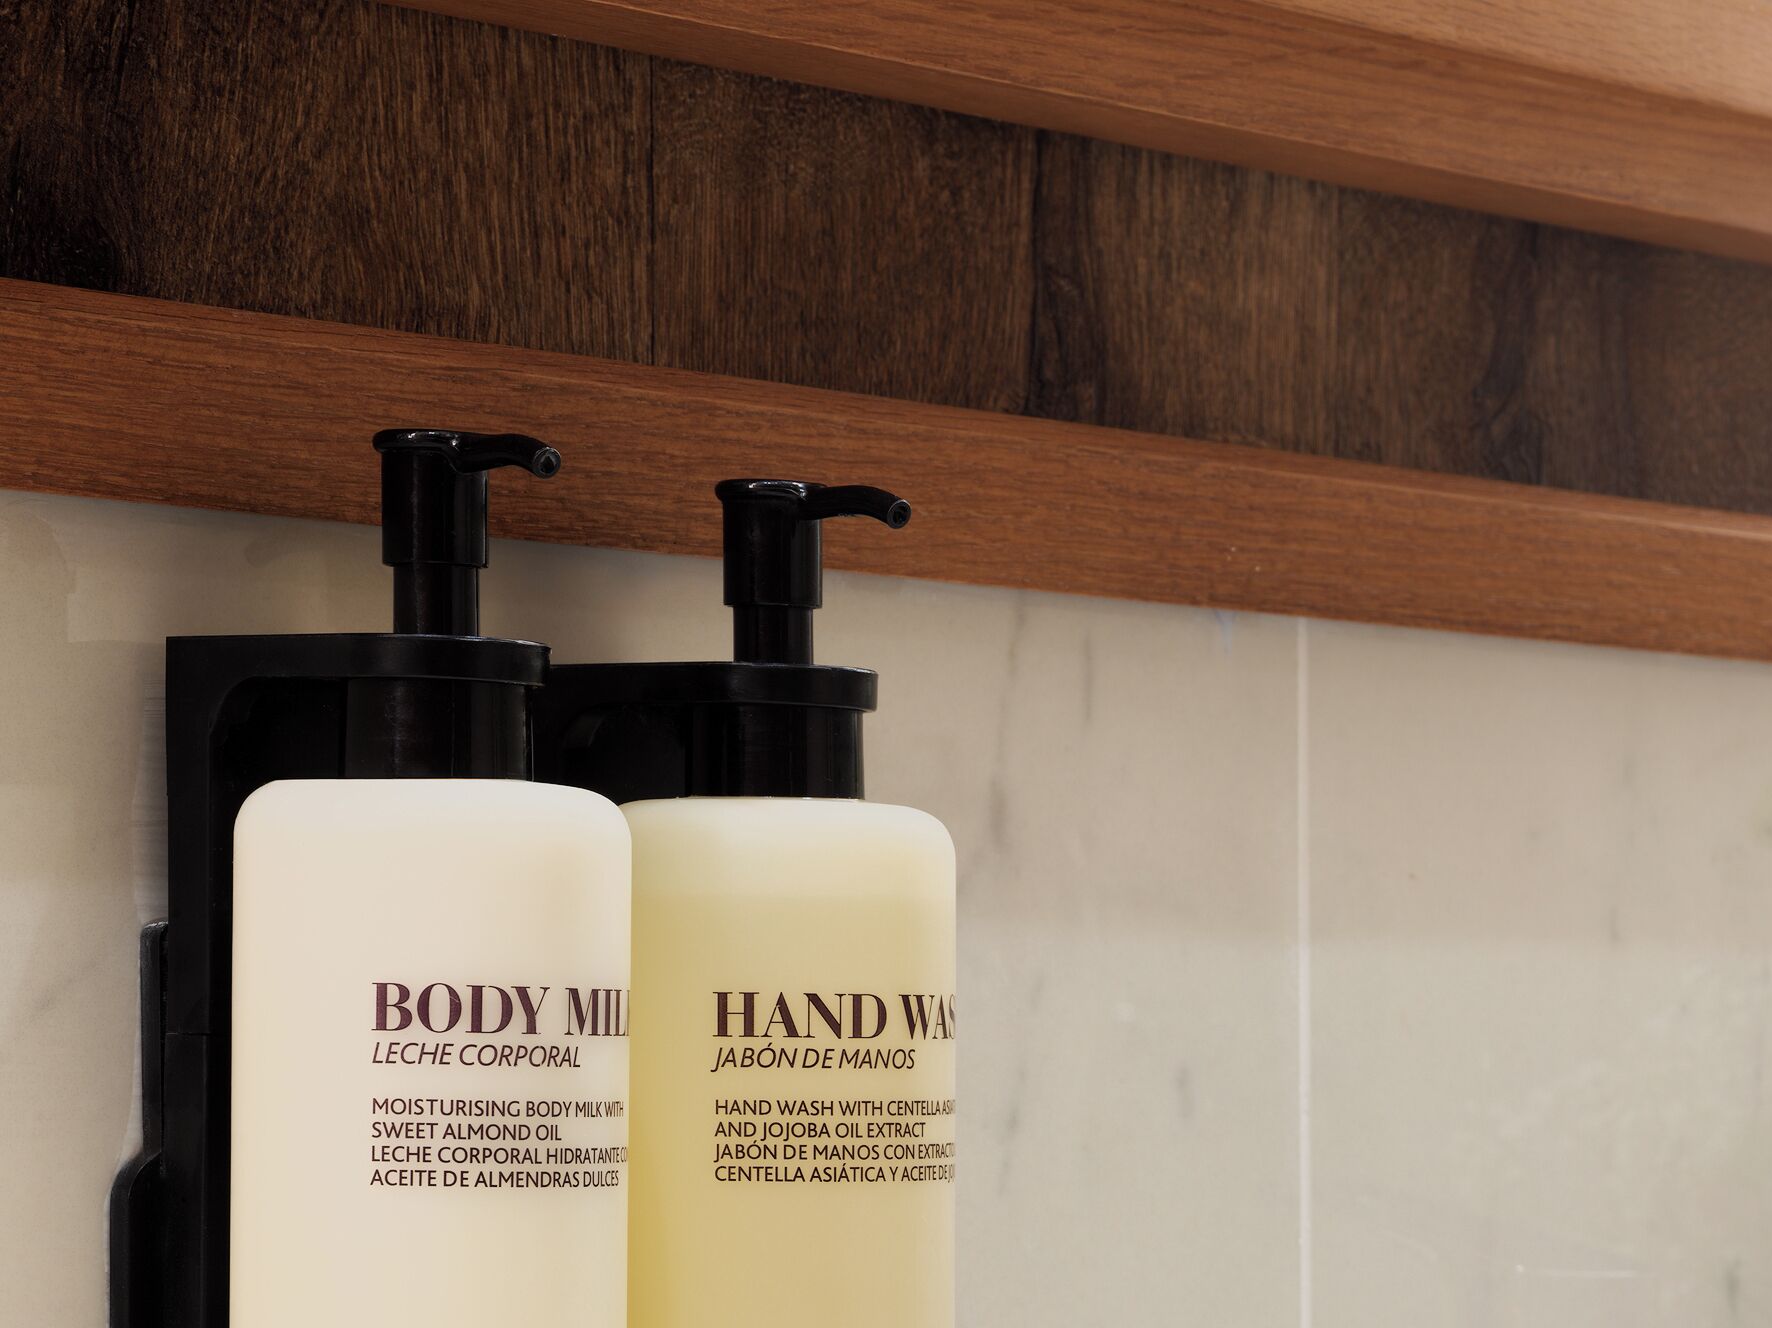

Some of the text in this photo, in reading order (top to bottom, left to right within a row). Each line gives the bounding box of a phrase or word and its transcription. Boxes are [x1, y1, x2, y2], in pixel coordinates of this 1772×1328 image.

[371, 982, 550, 1035] BODY
[712, 991, 888, 1040] HAND
[371, 1042, 581, 1068] LECHE CORPORAL
[710, 1042, 916, 1073] JABÓN DE MANOS
[371, 1097, 624, 1118] MOISTURISING BODY MILK WITH
[714, 1099, 772, 1116] HAND
[776, 1100, 834, 1117] WASH
[838, 1100, 883, 1116] WITH
[886, 1100, 941, 1117] CENTELLA
[371, 1121, 562, 1142] SWEET ALMOND OIL
[714, 1121, 926, 1142] AND JOJOBA OIL EXTRACT
[371, 1145, 432, 1164] LECHE
[437, 1146, 542, 1165] CORPORAL
[546, 1147, 620, 1165] HIDRATANTE
[713, 1140, 778, 1163] JABÓN
[783, 1145, 808, 1161] DE
[812, 1144, 880, 1162] MANOS
[883, 1144, 916, 1161] CON
[370, 1168, 620, 1189] ACEITE DE ALMENDRAS DULCES
[714, 1165, 806, 1183] CENTELLA
[809, 1162, 886, 1184] ASIÁTICA
[889, 1165, 898, 1183] Y
[901, 1165, 937, 1182] ACEITE
[938, 1164, 948, 1180] DE
